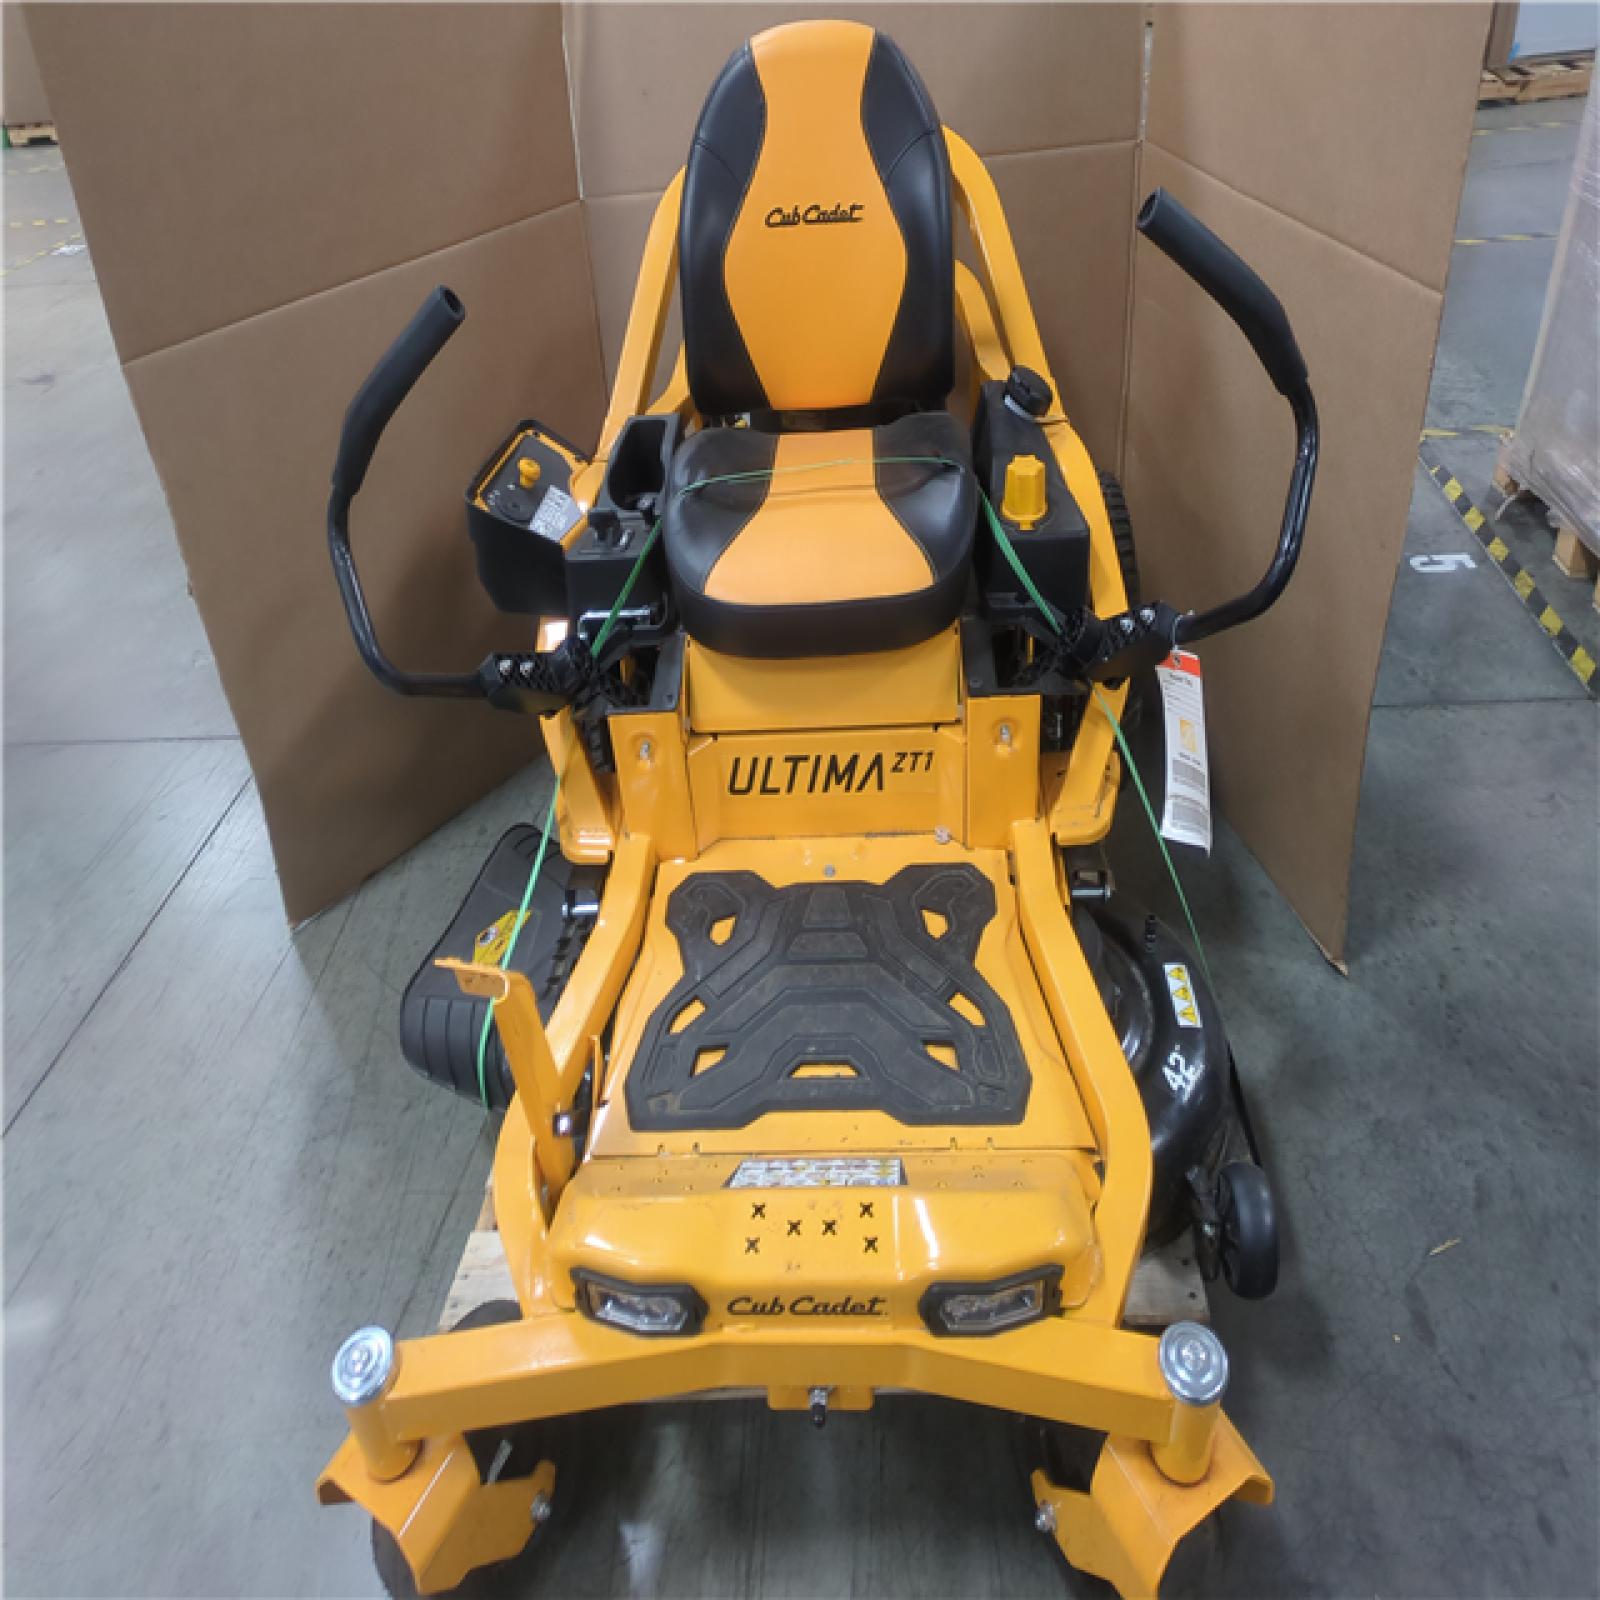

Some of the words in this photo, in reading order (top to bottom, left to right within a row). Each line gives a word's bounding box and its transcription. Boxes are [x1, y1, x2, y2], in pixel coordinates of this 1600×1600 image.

[765, 205, 800, 228] Cub
[802, 202, 864, 224] Cadet
[728, 752, 884, 795] ULTIMA
[890, 751, 934, 773] ZT1
[727, 1296, 785, 1316] Cub
[789, 1296, 886, 1316] Cadet
